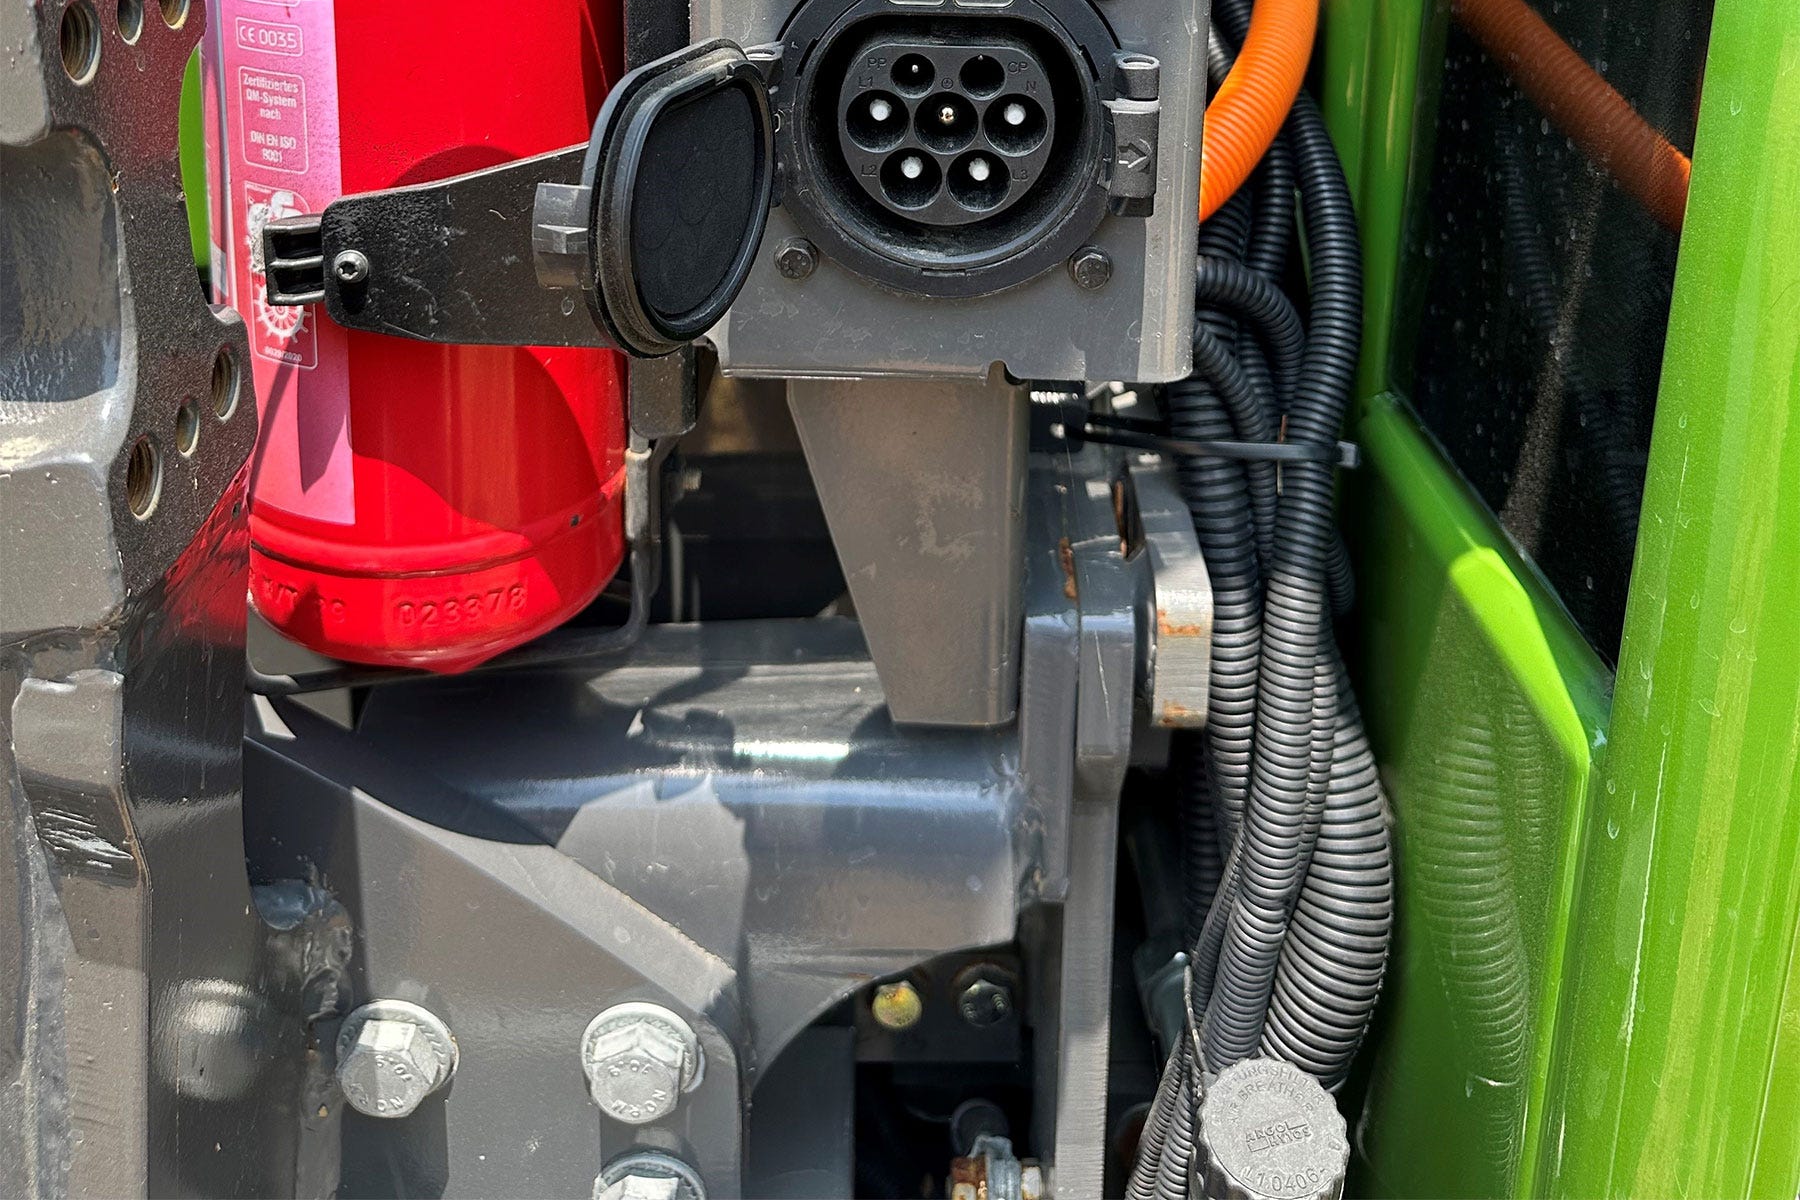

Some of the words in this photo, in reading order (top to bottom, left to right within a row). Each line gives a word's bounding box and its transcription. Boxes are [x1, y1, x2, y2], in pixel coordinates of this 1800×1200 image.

[259, 29, 298, 49] 0035
[867, 57, 887, 68] PP
[1007, 61, 1029, 74] CP
[243, 73, 299, 94] Zertifiziertes
[858, 76, 874, 89] L1
[1026, 80, 1037, 93] N
[246, 88, 297, 108] QM-System
[259, 107, 282, 120] nach
[250, 130, 266, 145] DIN
[266, 133, 278, 147] EN
[279, 135, 297, 150] ISO
[861, 165, 878, 178] L2
[1012, 169, 1029, 182] L3
